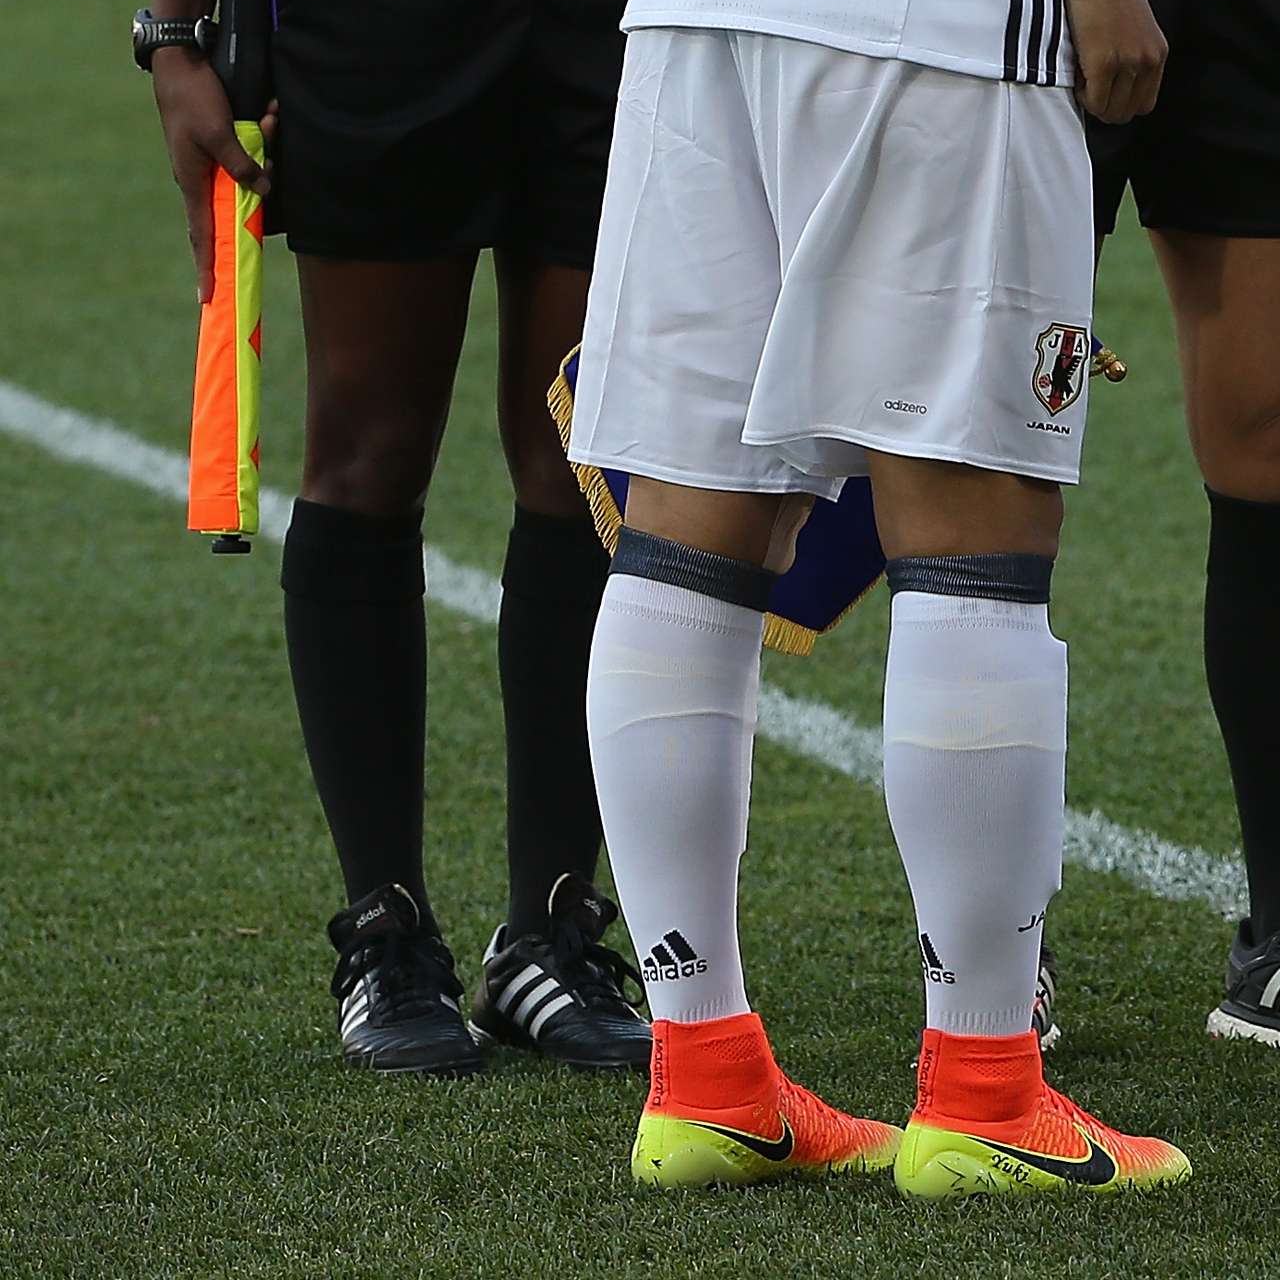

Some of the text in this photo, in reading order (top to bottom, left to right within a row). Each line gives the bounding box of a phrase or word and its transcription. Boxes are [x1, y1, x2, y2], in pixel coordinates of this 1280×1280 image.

[884, 398, 928, 416] adizero
[1025, 420, 1071, 435] JAPAN
[643, 958, 708, 983] adidas
[991, 1154, 1033, 1187] Yuki
